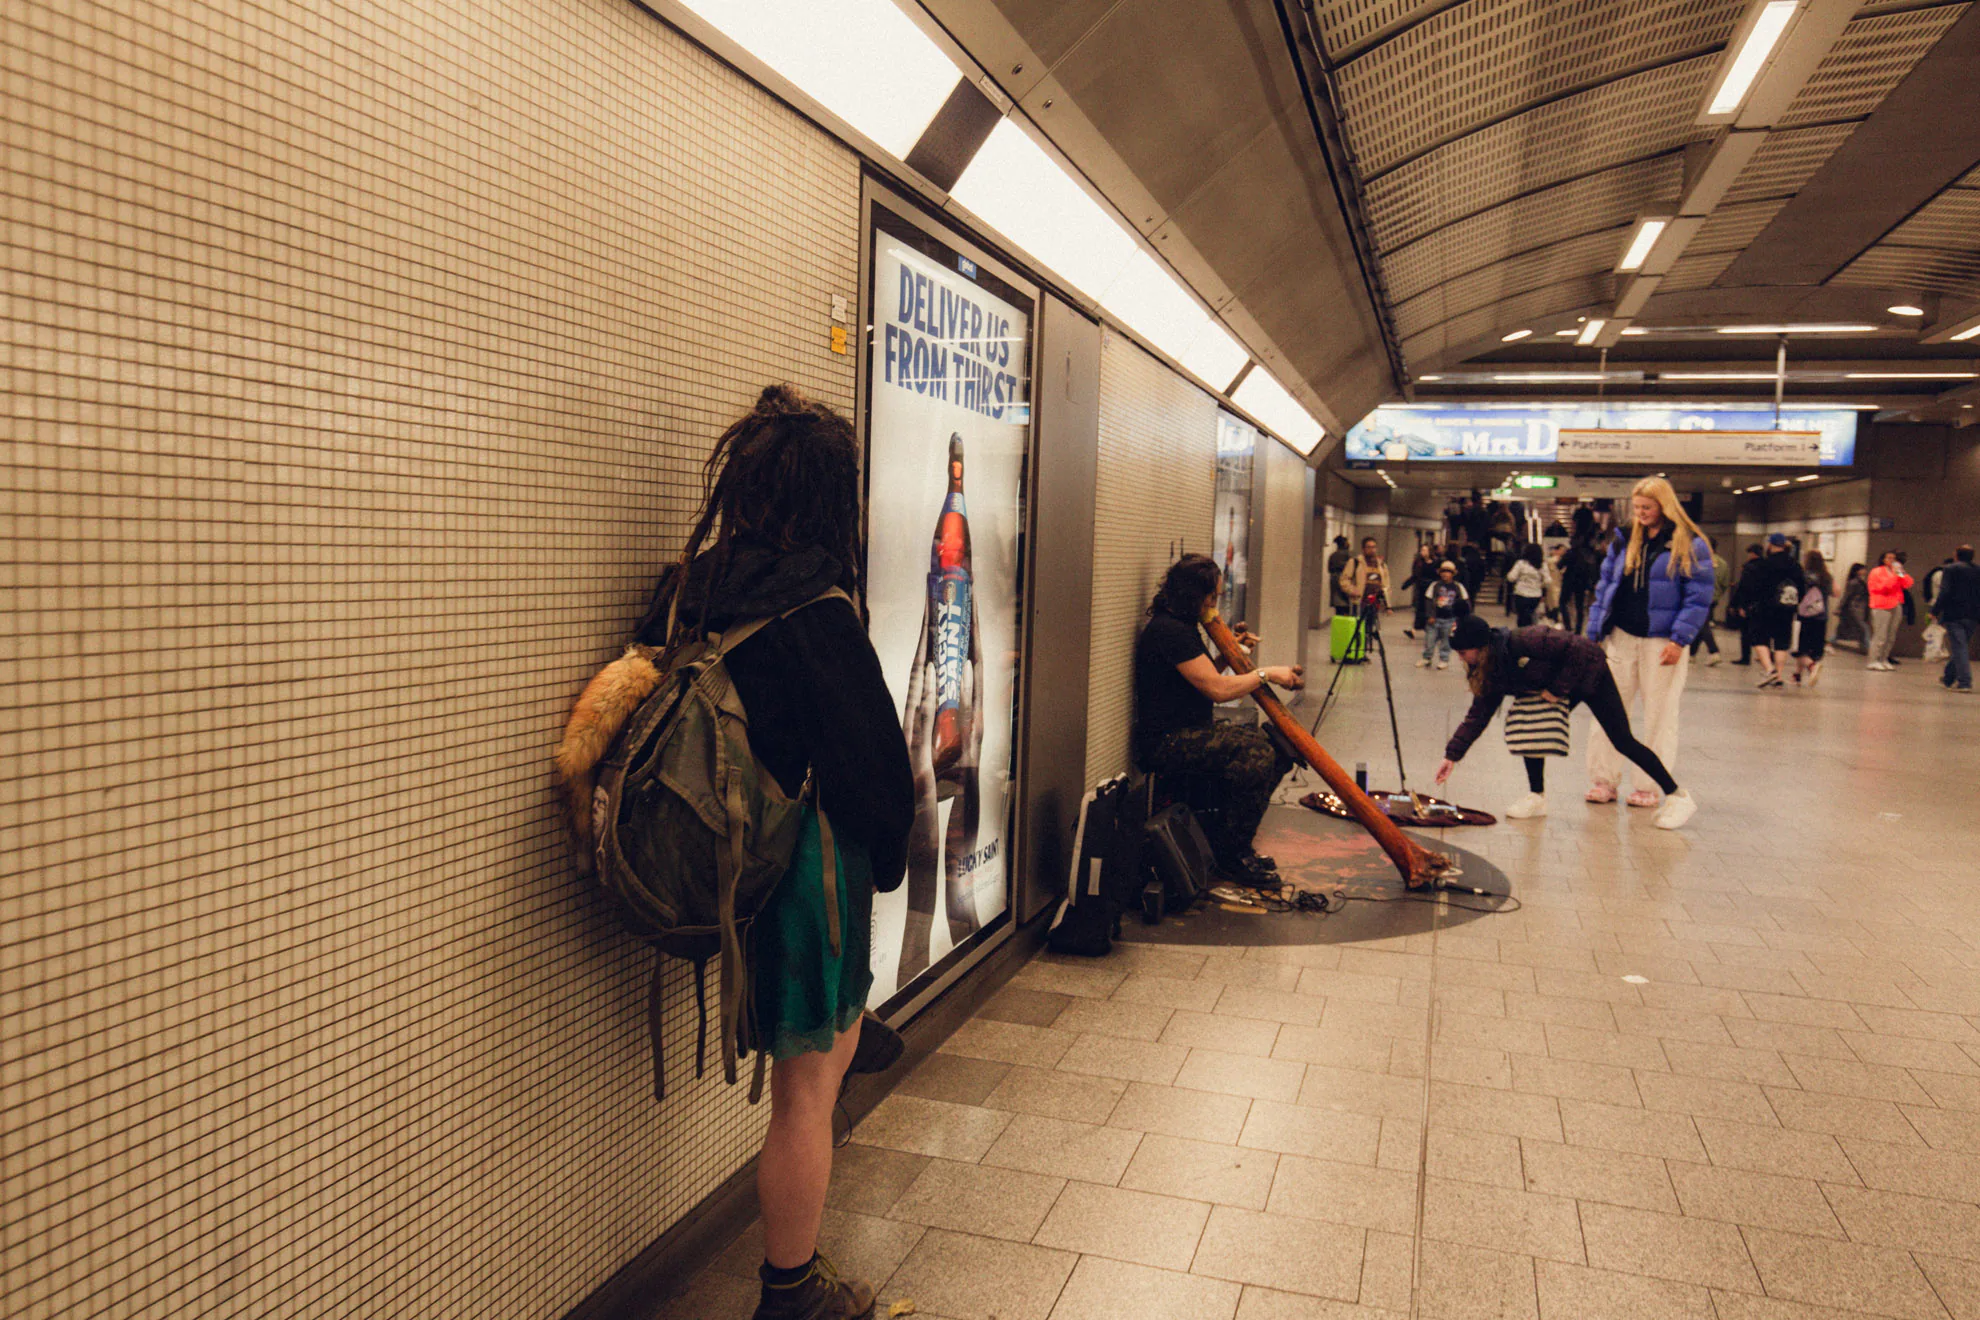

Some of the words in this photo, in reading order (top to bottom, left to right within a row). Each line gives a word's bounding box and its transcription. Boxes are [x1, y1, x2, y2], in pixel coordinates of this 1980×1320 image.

[898, 263, 983, 358] DELIVER
[986, 312, 1010, 368] US
[885, 322, 947, 401] FROM
[953, 352, 1017, 420] THIRST
[1572, 440, 1621, 450] Platform
[1624, 440, 1631, 450] 2
[1744, 442, 1797, 452] Platform
[938, 602, 948, 707] LUCKY
[947, 602, 962, 701] SAINT
[957, 848, 983, 878] LUCKY
[982, 838, 1000, 864] SAINT
